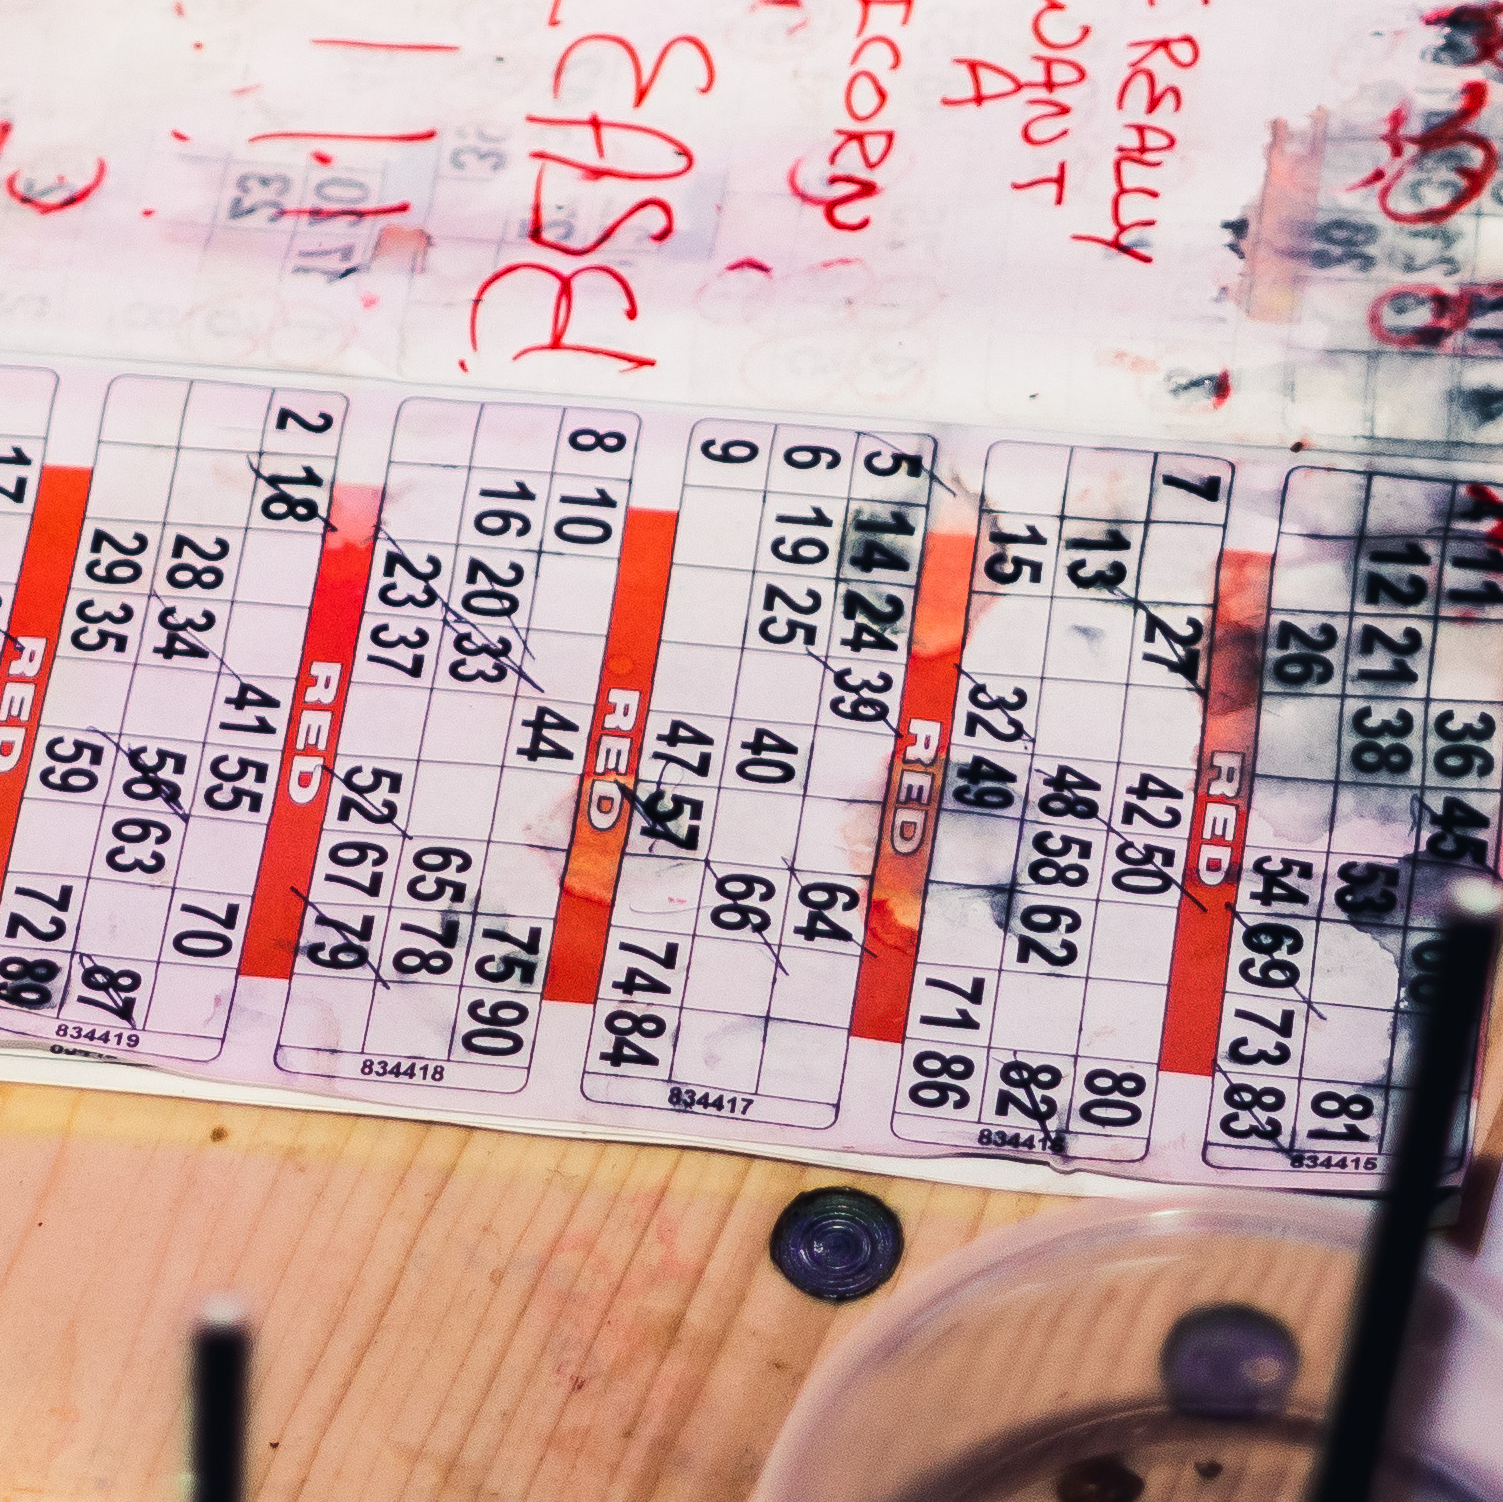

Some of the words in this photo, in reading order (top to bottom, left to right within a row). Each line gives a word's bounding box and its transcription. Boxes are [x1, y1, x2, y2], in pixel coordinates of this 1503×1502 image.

[941, 58, 1024, 107] A
[1071, 33, 1199, 264] REALLY
[275, 407, 334, 434] 2
[567, 427, 628, 454] 8
[699, 437, 760, 465] 9
[782, 445, 842, 472] 6
[472, 479, 537, 539] 16
[553, 487, 614, 546] 10
[1160, 473, 1223, 503] 7
[85, 528, 149, 586] 29
[165, 534, 231, 590] 28
[769, 506, 834, 566] 19
[850, 510, 917, 573] 14
[982, 523, 1049, 586] 15
[1065, 530, 1132, 590] 13
[377, 552, 442, 610] 23
[460, 557, 525, 618] 20
[1362, 541, 1429, 608] 12
[69, 599, 136, 654] 35
[152, 607, 218, 661] 34
[757, 584, 823, 647] 25
[838, 591, 900, 653] 24
[366, 623, 430, 680] 37
[1141, 614, 1205, 681] 27
[1274, 621, 1339, 687] 26
[1356, 624, 1424, 685] 21
[215, 680, 283, 738] 41
[828, 665, 894, 723] 39
[965, 685, 1029, 744] 32
[288, 661, 345, 805] RED
[514, 705, 580, 764] 44
[587, 688, 642, 831] RED
[653, 719, 716, 787] 47
[734, 726, 801, 785] 40
[1349, 704, 1415, 774] 38
[1431, 709, 1497, 780] 36
[38, 736, 105, 794] 59
[202, 754, 269, 814] 55
[338, 764, 403, 824] 52
[889, 718, 941, 856] RED
[951, 755, 1020, 810] 49
[1036, 764, 1102, 820] 48
[1121, 773, 1185, 830] 42
[1195, 751, 1245, 887] RED
[105, 817, 172, 874] 63
[1026, 831, 1093, 889] 58
[1425, 795, 1492, 868] 45
[327, 841, 390, 899] 67
[406, 846, 473, 904] 65
[1111, 843, 1176, 896] 50
[1251, 854, 1314, 908] 54
[3, 883, 74, 943] 72
[171, 902, 240, 958] 70
[709, 871, 777, 933] 66
[791, 881, 861, 943] 64
[307, 915, 376, 971] 79
[392, 919, 459, 977] 78
[474, 926, 542, 986] 75
[1015, 904, 1081, 969] 62
[1239, 921, 1306, 990] 69
[610, 941, 680, 996] 74
[461, 998, 529, 1057] 90
[917, 975, 986, 1034] 71
[55, 1023, 141, 1049] 834419
[597, 1011, 668, 1069] 84
[1228, 1007, 1296, 1068] 73
[360, 1058, 445, 1083] 834418
[904, 1050, 976, 1112] 86
[1077, 1068, 1147, 1128] 80
[667, 1087, 754, 1117] 834417
[1218, 1082, 1287, 1143] 83
[1310, 1091, 1375, 1144] 81
[1290, 1153, 1379, 1171] 834415
